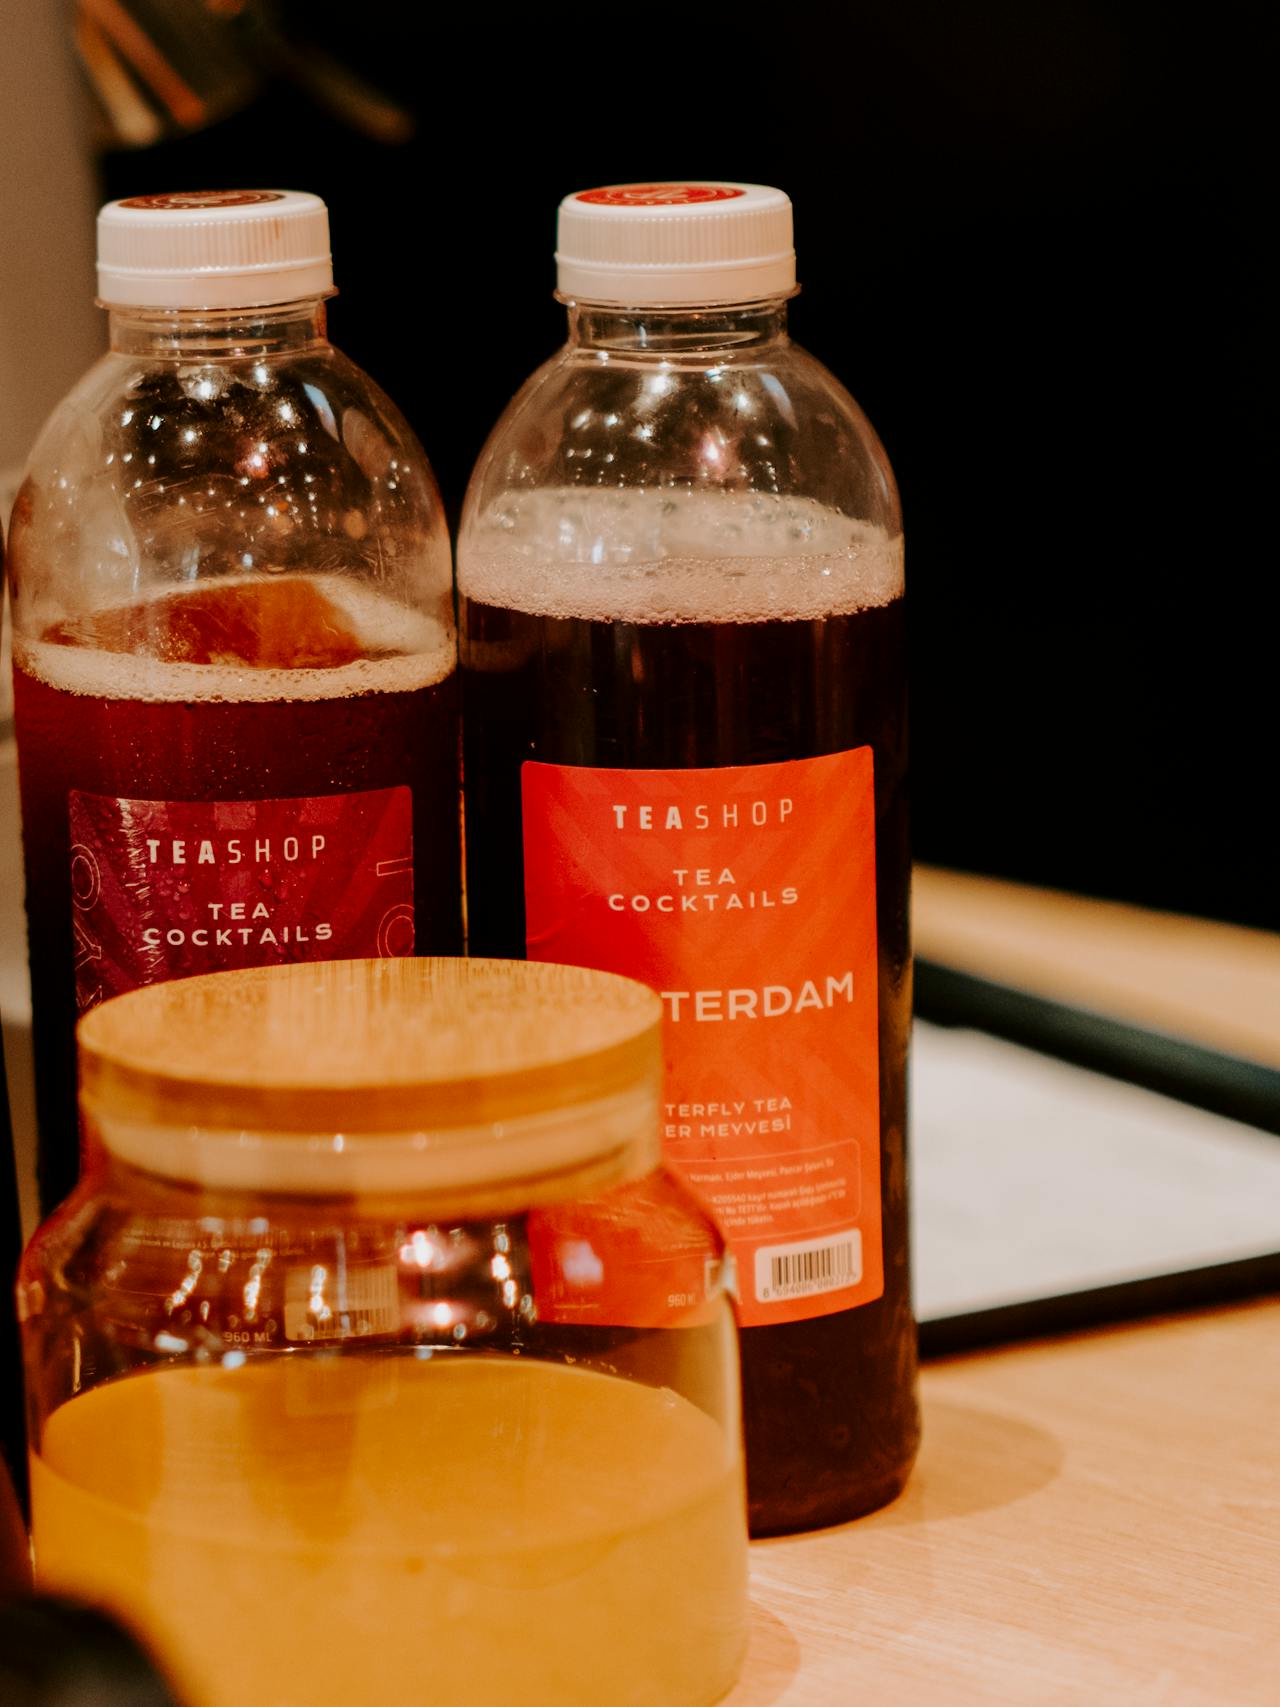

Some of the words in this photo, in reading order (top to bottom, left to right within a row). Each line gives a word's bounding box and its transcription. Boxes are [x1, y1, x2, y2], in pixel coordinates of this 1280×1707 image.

[613, 799, 793, 830] TEASHOP
[146, 835, 325, 864] TEASHOP
[673, 867, 736, 886] TEA
[608, 887, 799, 913] COCKTAILS
[208, 902, 272, 920] TEA
[142, 923, 334, 947] COCKTAILS
[753, 1096, 793, 1113] TEA
[223, 1331, 250, 1343] 960
[254, 1331, 272, 1343] ML
